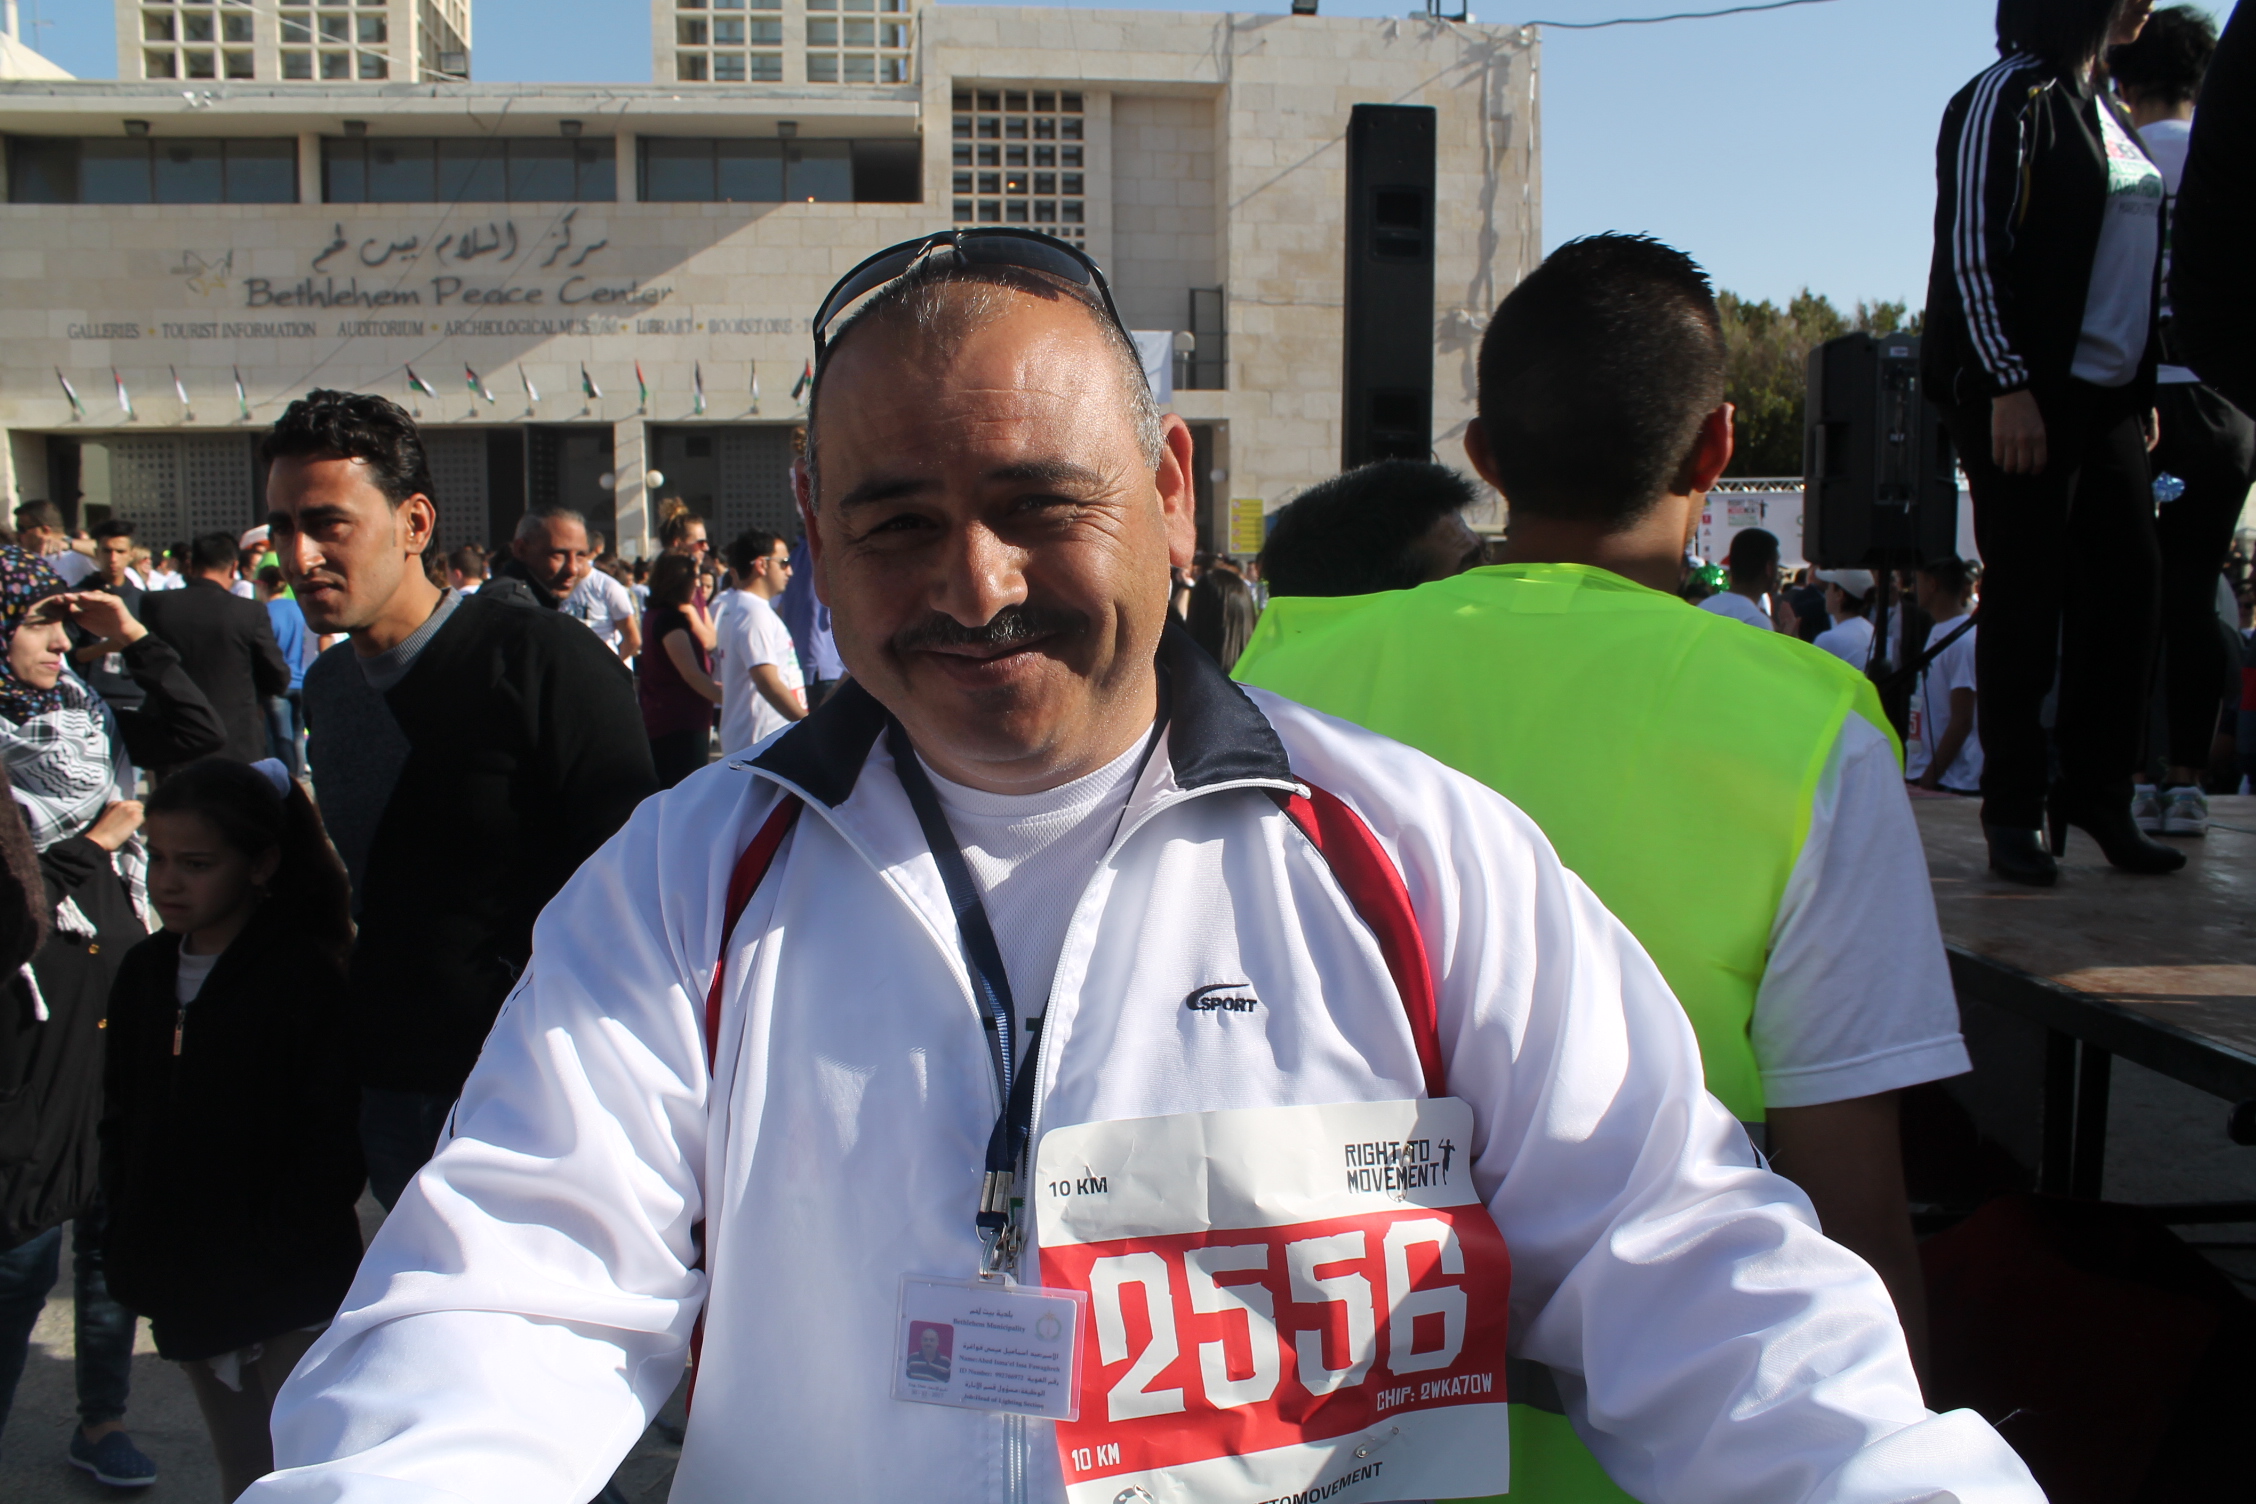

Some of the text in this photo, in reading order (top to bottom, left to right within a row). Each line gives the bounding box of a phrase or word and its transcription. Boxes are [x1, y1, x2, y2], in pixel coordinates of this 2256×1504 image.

[243, 275, 674, 308] Bethlehem Peace Center
[67, 323, 140, 339] GALLERIES
[161, 322, 218, 338] TOURIST
[222, 321, 317, 338] INFORMATION
[337, 320, 424, 337] AUDITORIUM
[636, 318, 693, 335] LIBRARY
[708, 317, 793, 335] BOOKSTORE
[1200, 997, 1258, 1012] SPORT
[1344, 1139, 1430, 1167] RIGHT TO
[1049, 1176, 1109, 1198] 10 KM
[1346, 1162, 1440, 1194] MOVEMENT
[953, 1318, 1026, 1333] Bethlehem Municipality
[1088, 1217, 1468, 1422] 2556
[1377, 1386, 1415, 1412] CHIP:
[1071, 1443, 1121, 1470] 10 KM
[1257, 1461, 1383, 1504] OMOVEMENT
